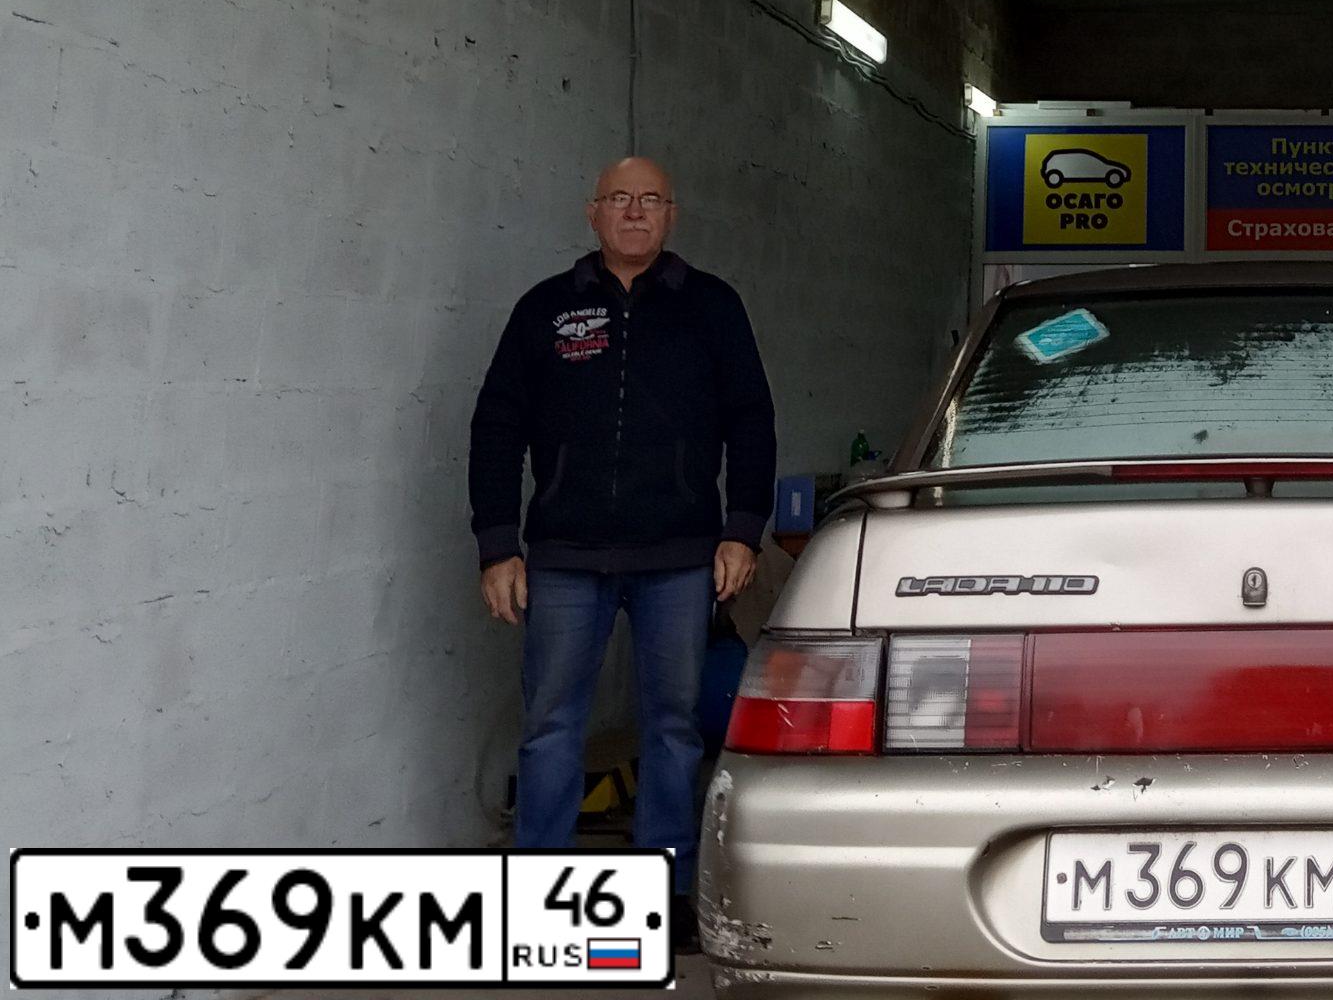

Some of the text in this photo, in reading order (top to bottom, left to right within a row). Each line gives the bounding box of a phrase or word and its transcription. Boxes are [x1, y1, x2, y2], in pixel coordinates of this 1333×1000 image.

[1045, 192, 1124, 210] ОСАГО
[1060, 212, 1109, 230] PRO
[553, 311, 571, 328] LOS
[570, 307, 608, 318] ANGELES
[896, 574, 1100, 597] LADA 110
